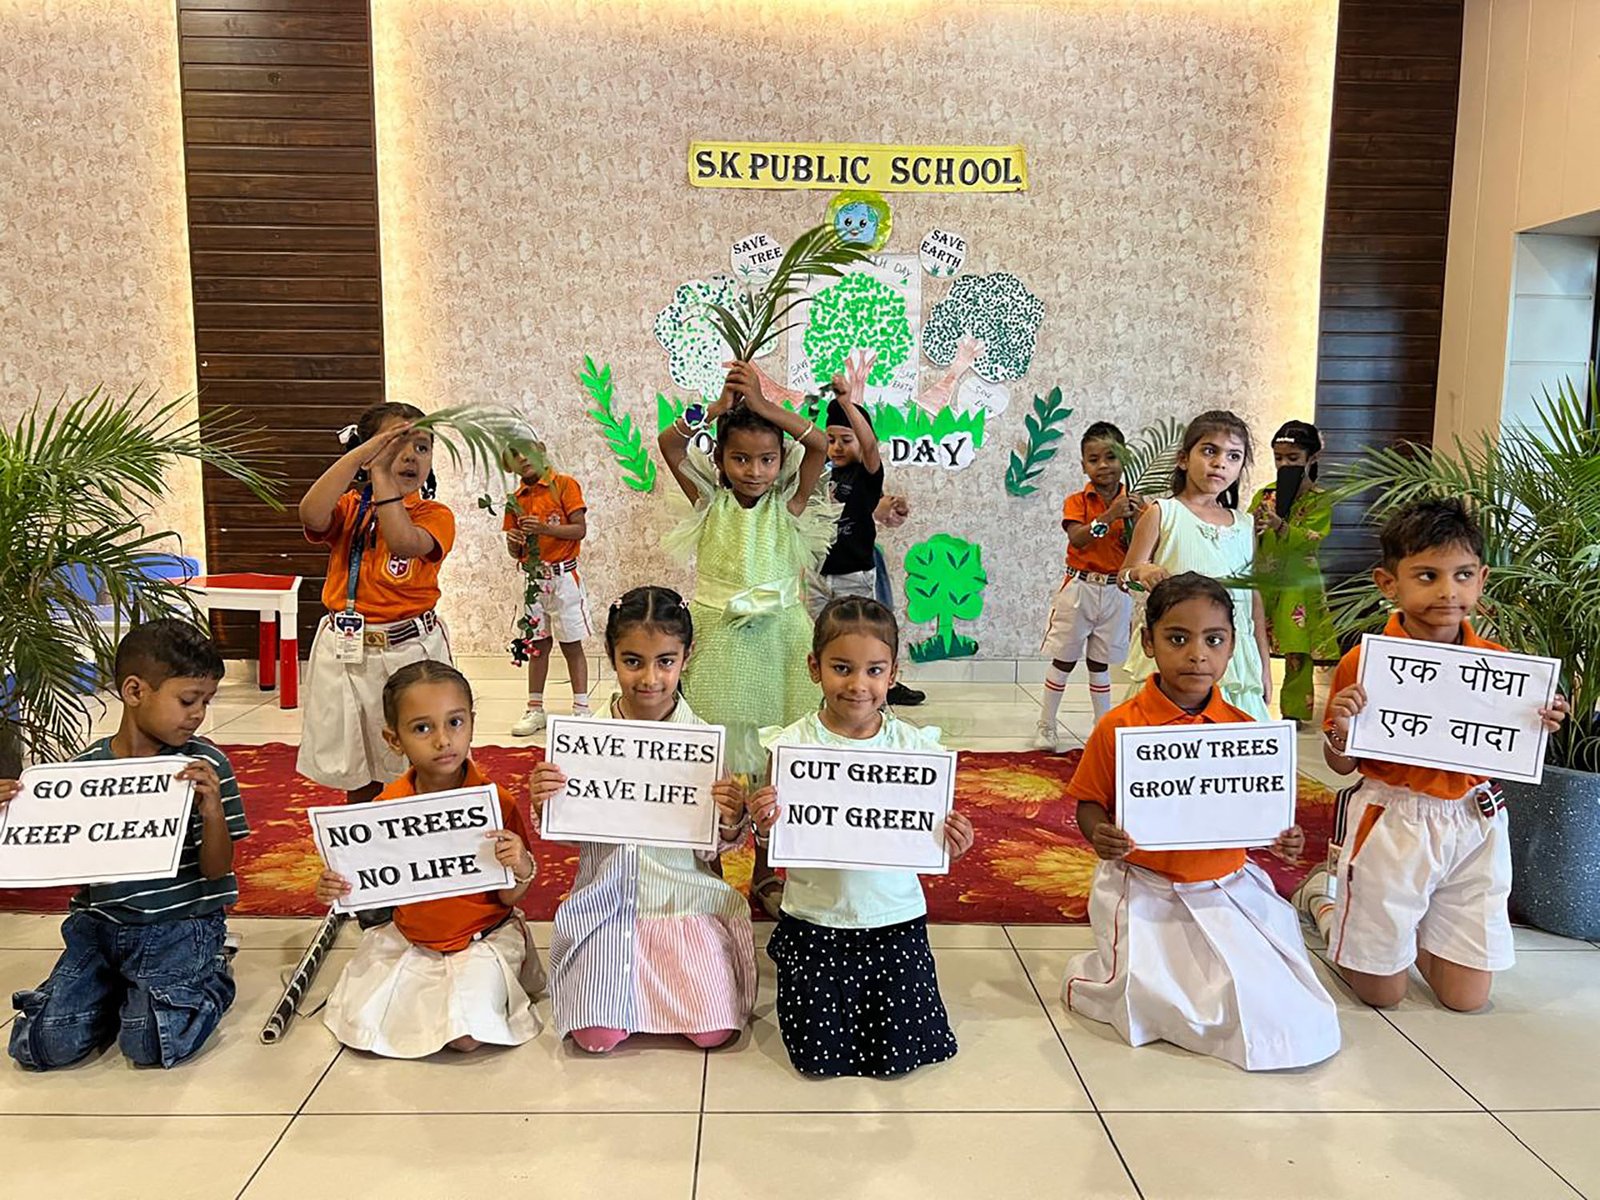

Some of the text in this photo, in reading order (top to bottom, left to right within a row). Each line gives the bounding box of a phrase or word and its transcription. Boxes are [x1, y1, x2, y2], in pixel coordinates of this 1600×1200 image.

[891, 156, 1021, 185] SCHOOL
[732, 235, 768, 254] SAVE
[921, 240, 962, 268] EARTH
[931, 229, 966, 252] SAVE
[748, 246, 783, 265] TREE
[892, 437, 967, 466] DAY
[1388, 655, 1530, 697] एक पौधा
[1379, 709, 1520, 752] एक वादा
[555, 734, 715, 764] SAVE TREES
[1136, 738, 1279, 762] GROW TREES
[33, 774, 172, 799] GO GREEN
[790, 760, 937, 785] CUT GREED
[1129, 775, 1286, 798] GROW FUTURE
[566, 778, 698, 806] SAVE LIFE
[2, 817, 180, 846] KEEP CLEAN
[327, 806, 489, 848] NO TREES
[787, 804, 935, 832] NOT GREEN
[357, 854, 482, 890] NO LIFE
